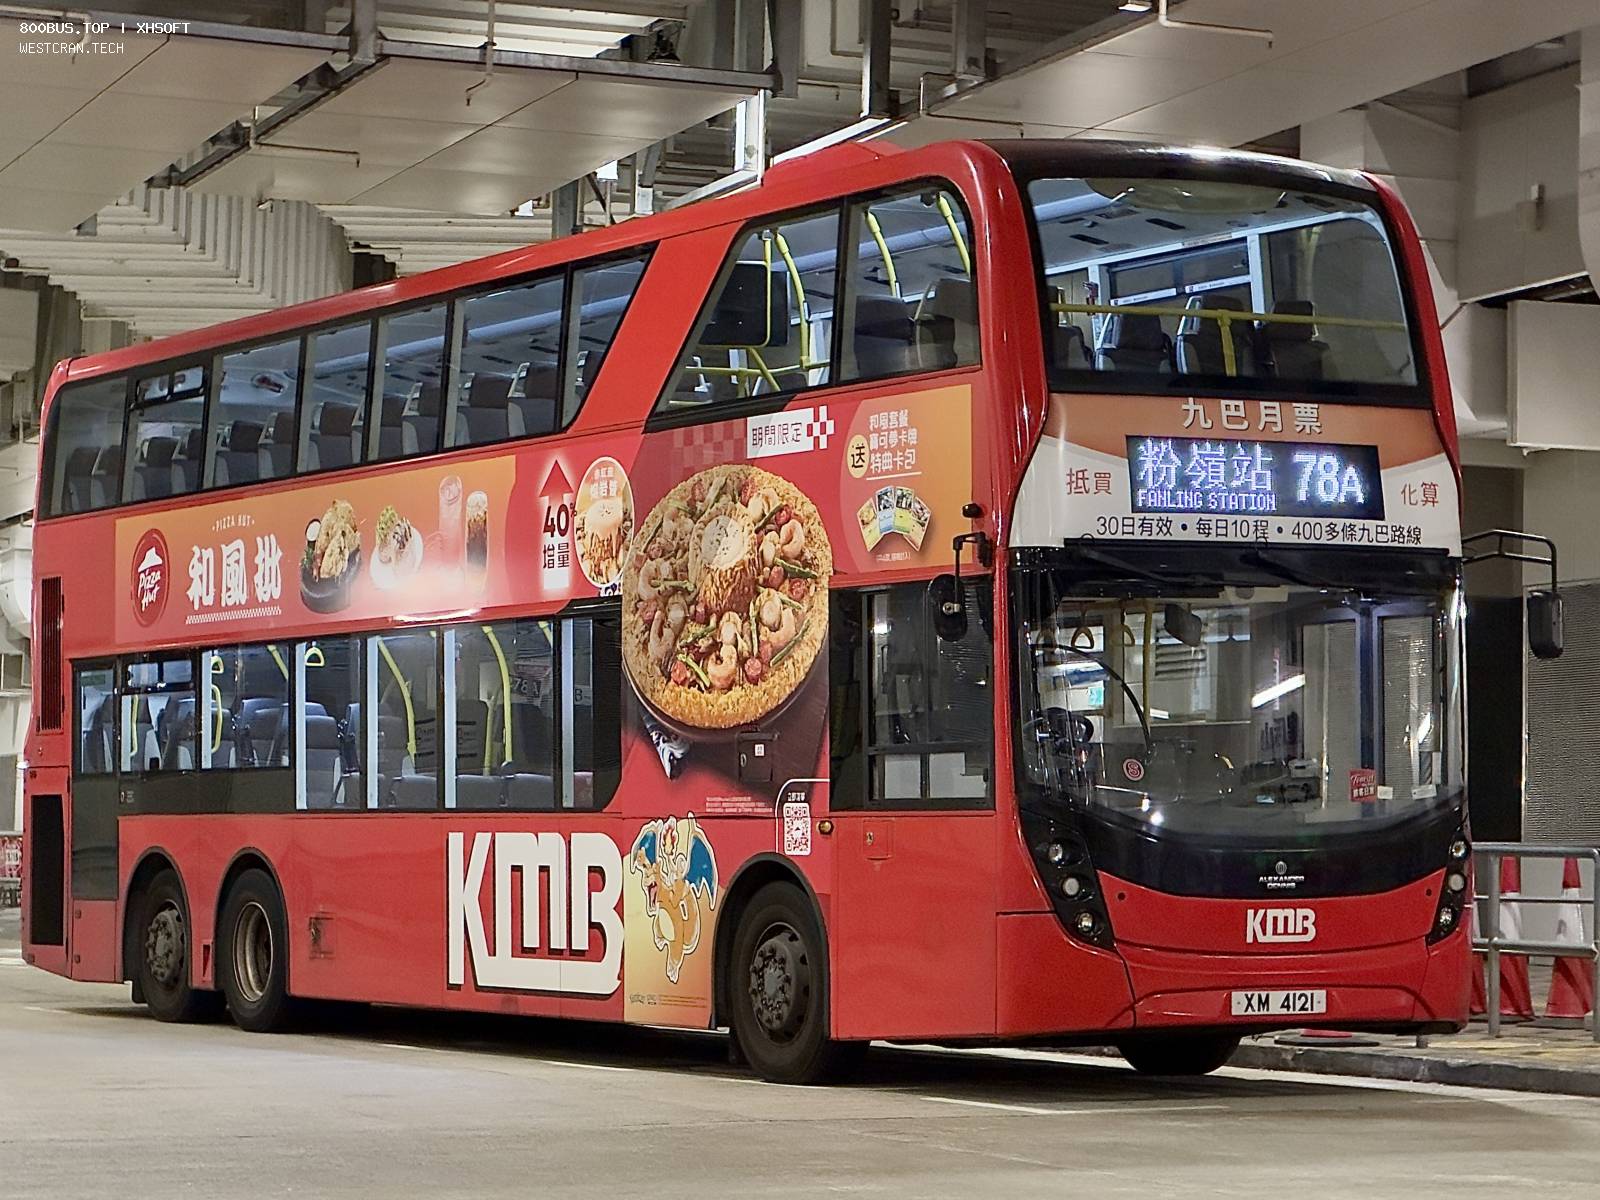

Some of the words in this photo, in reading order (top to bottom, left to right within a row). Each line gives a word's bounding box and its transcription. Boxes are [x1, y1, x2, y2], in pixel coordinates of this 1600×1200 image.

[1181, 397, 1322, 435] 九巴月票
[751, 422, 802, 447] 期間限定
[851, 443, 866, 468] 送
[1137, 437, 1273, 491] 粉嶺站
[1066, 467, 1112, 495] 抵買
[1293, 452, 1365, 504] 78A
[1137, 489, 1202, 509] FANLING
[1208, 492, 1277, 511] STATION
[1401, 481, 1439, 507] 化算
[215, 515, 235, 532] PIZZA
[237, 514, 252, 528] HUT
[1096, 516, 1173, 537] 30日有效
[1291, 521, 1422, 545] 400多條九巴路線
[543, 542, 570, 569] 增量
[137, 569, 161, 598] Pizza
[186, 533, 283, 611] 和風批
[141, 586, 160, 612] Hut
[448, 831, 625, 995] KMB
[1246, 908, 1317, 943] KMB
[1244, 993, 1270, 1013] XM
[1280, 992, 1315, 1012] 4121
